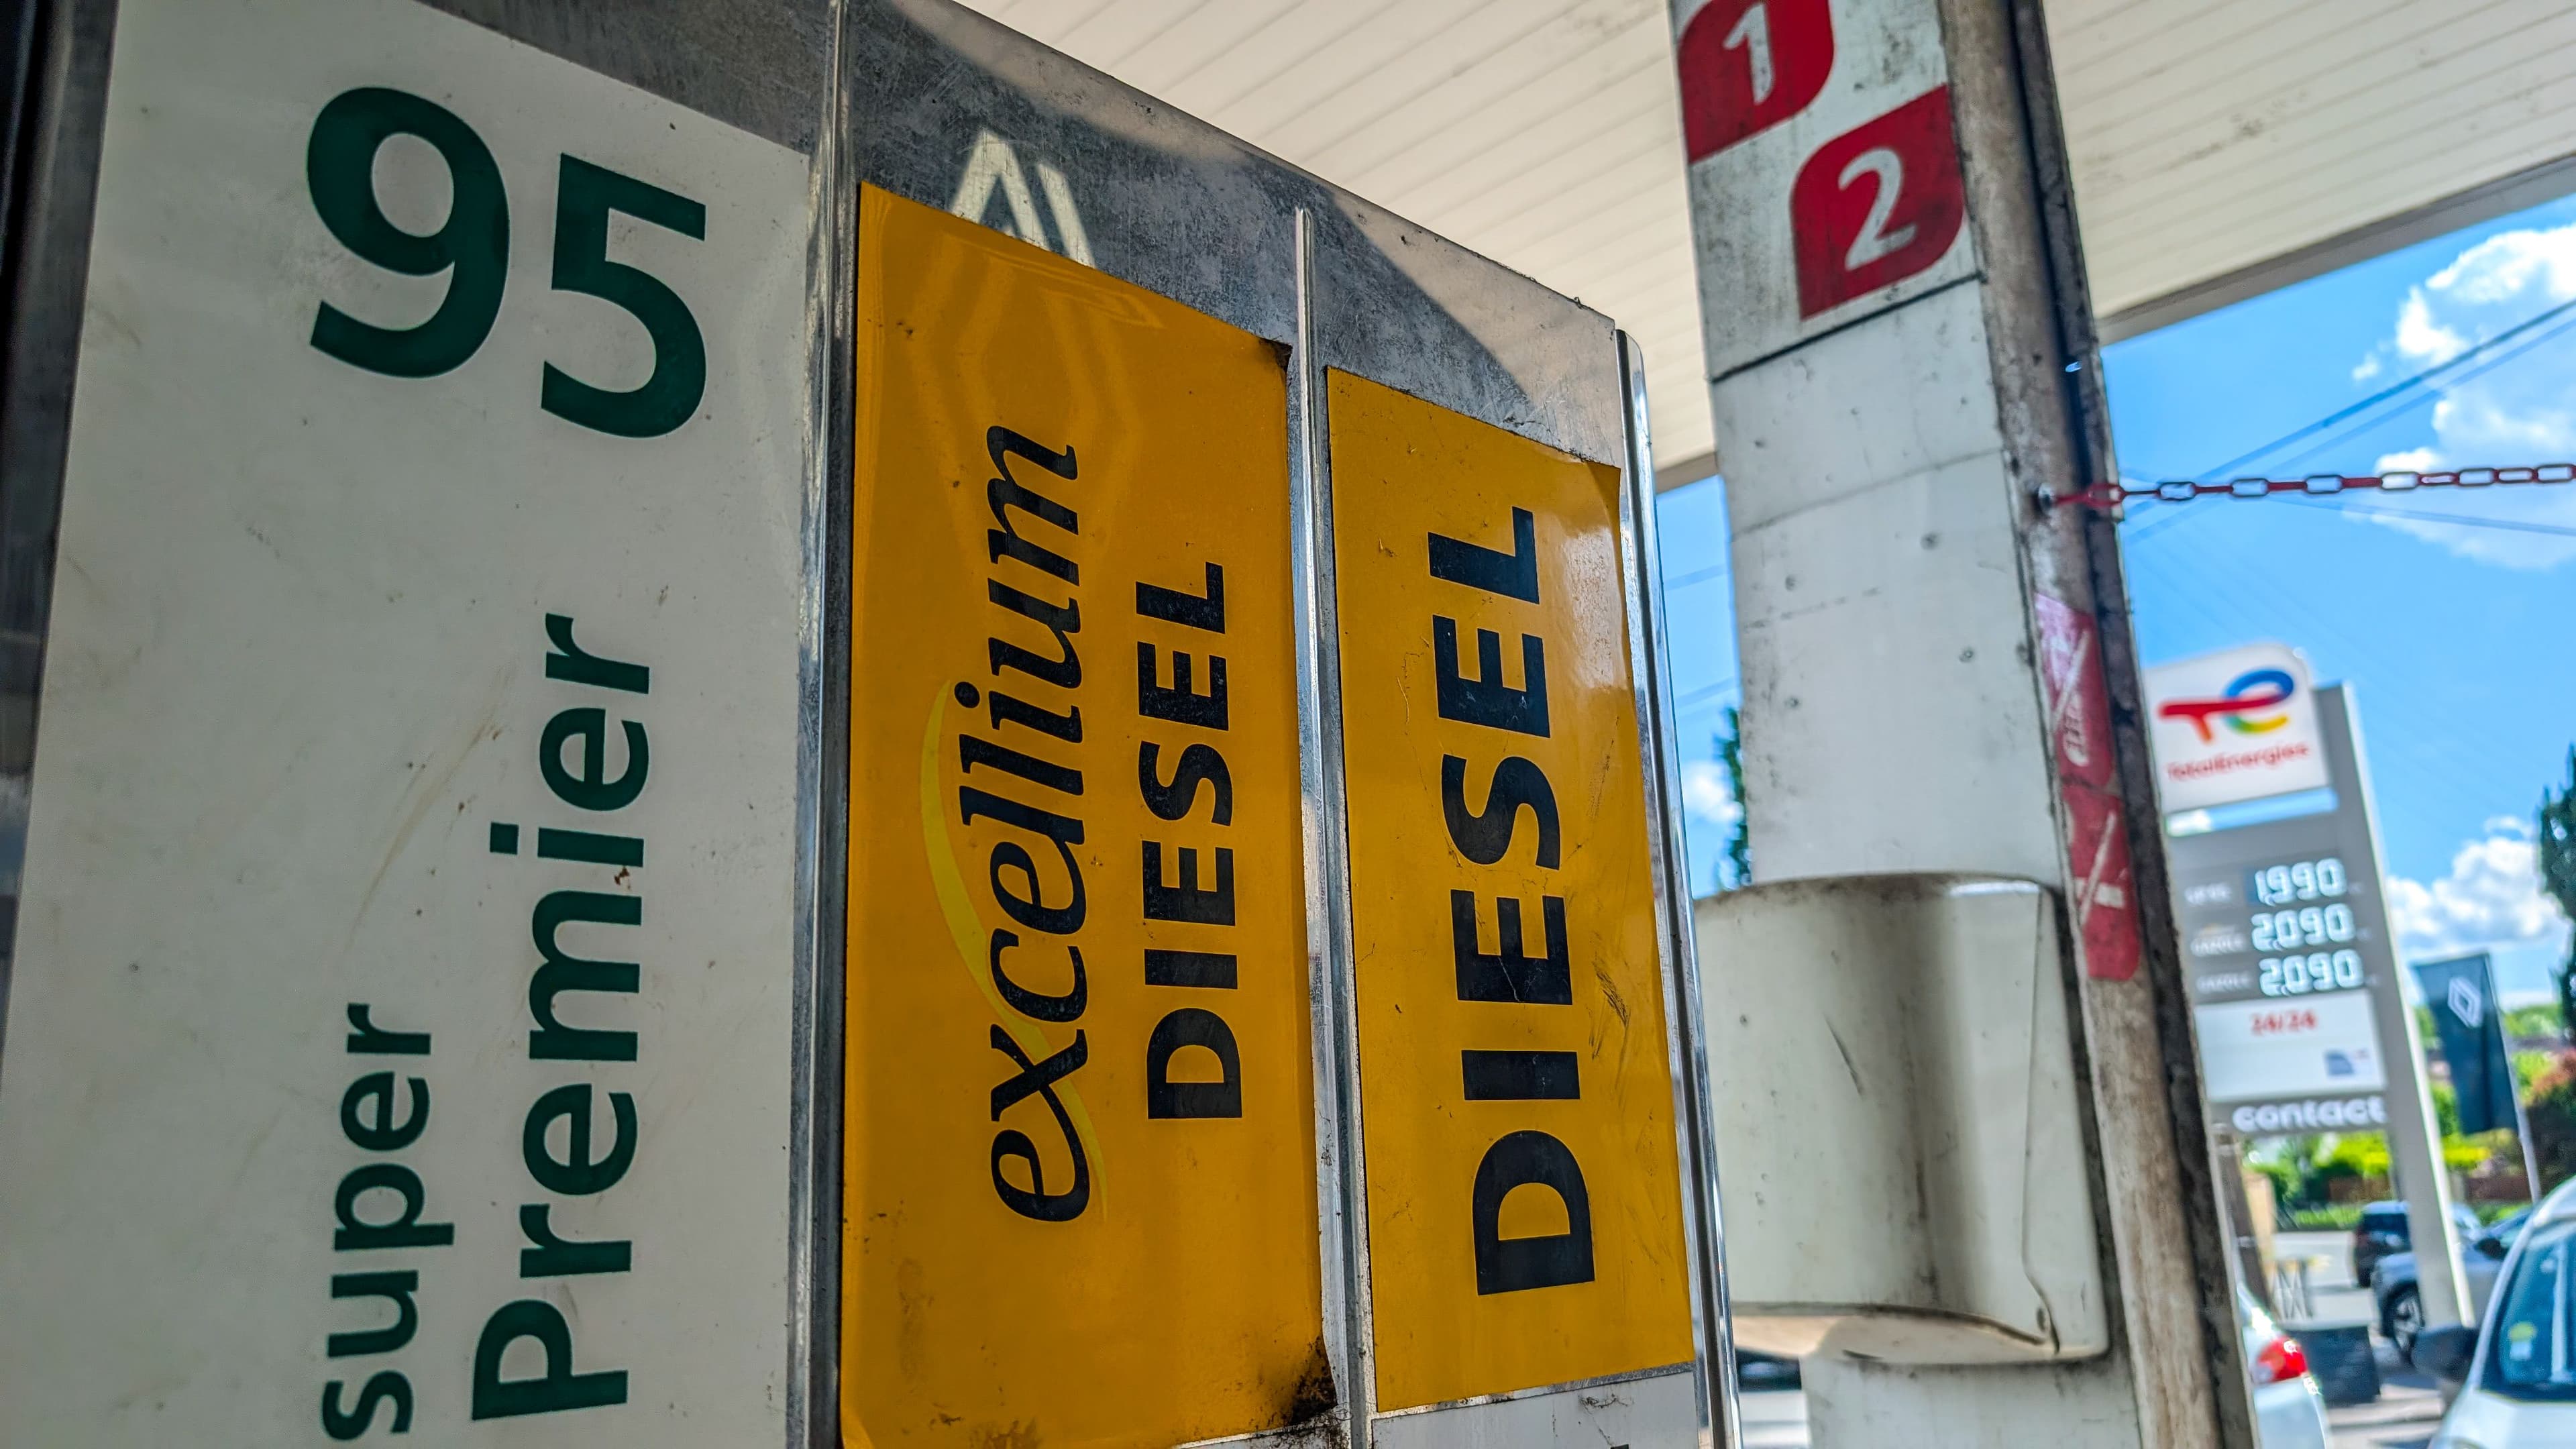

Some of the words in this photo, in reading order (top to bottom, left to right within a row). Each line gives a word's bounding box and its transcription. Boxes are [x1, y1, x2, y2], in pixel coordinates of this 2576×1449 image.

[1723, 3, 1775, 105] 1
[1837, 146, 1918, 272] 2
[305, 86, 707, 439] 95
[953, 423, 1092, 1223] excellium
[1134, 559, 1244, 1121] DIESEL
[1427, 504, 1596, 1297] DIESEL
[2165, 743, 2310, 782] TotalEnergies
[470, 612, 651, 1422] Premier
[2233, 1095, 2386, 1132] contact
[320, 1002, 455, 1442] super
